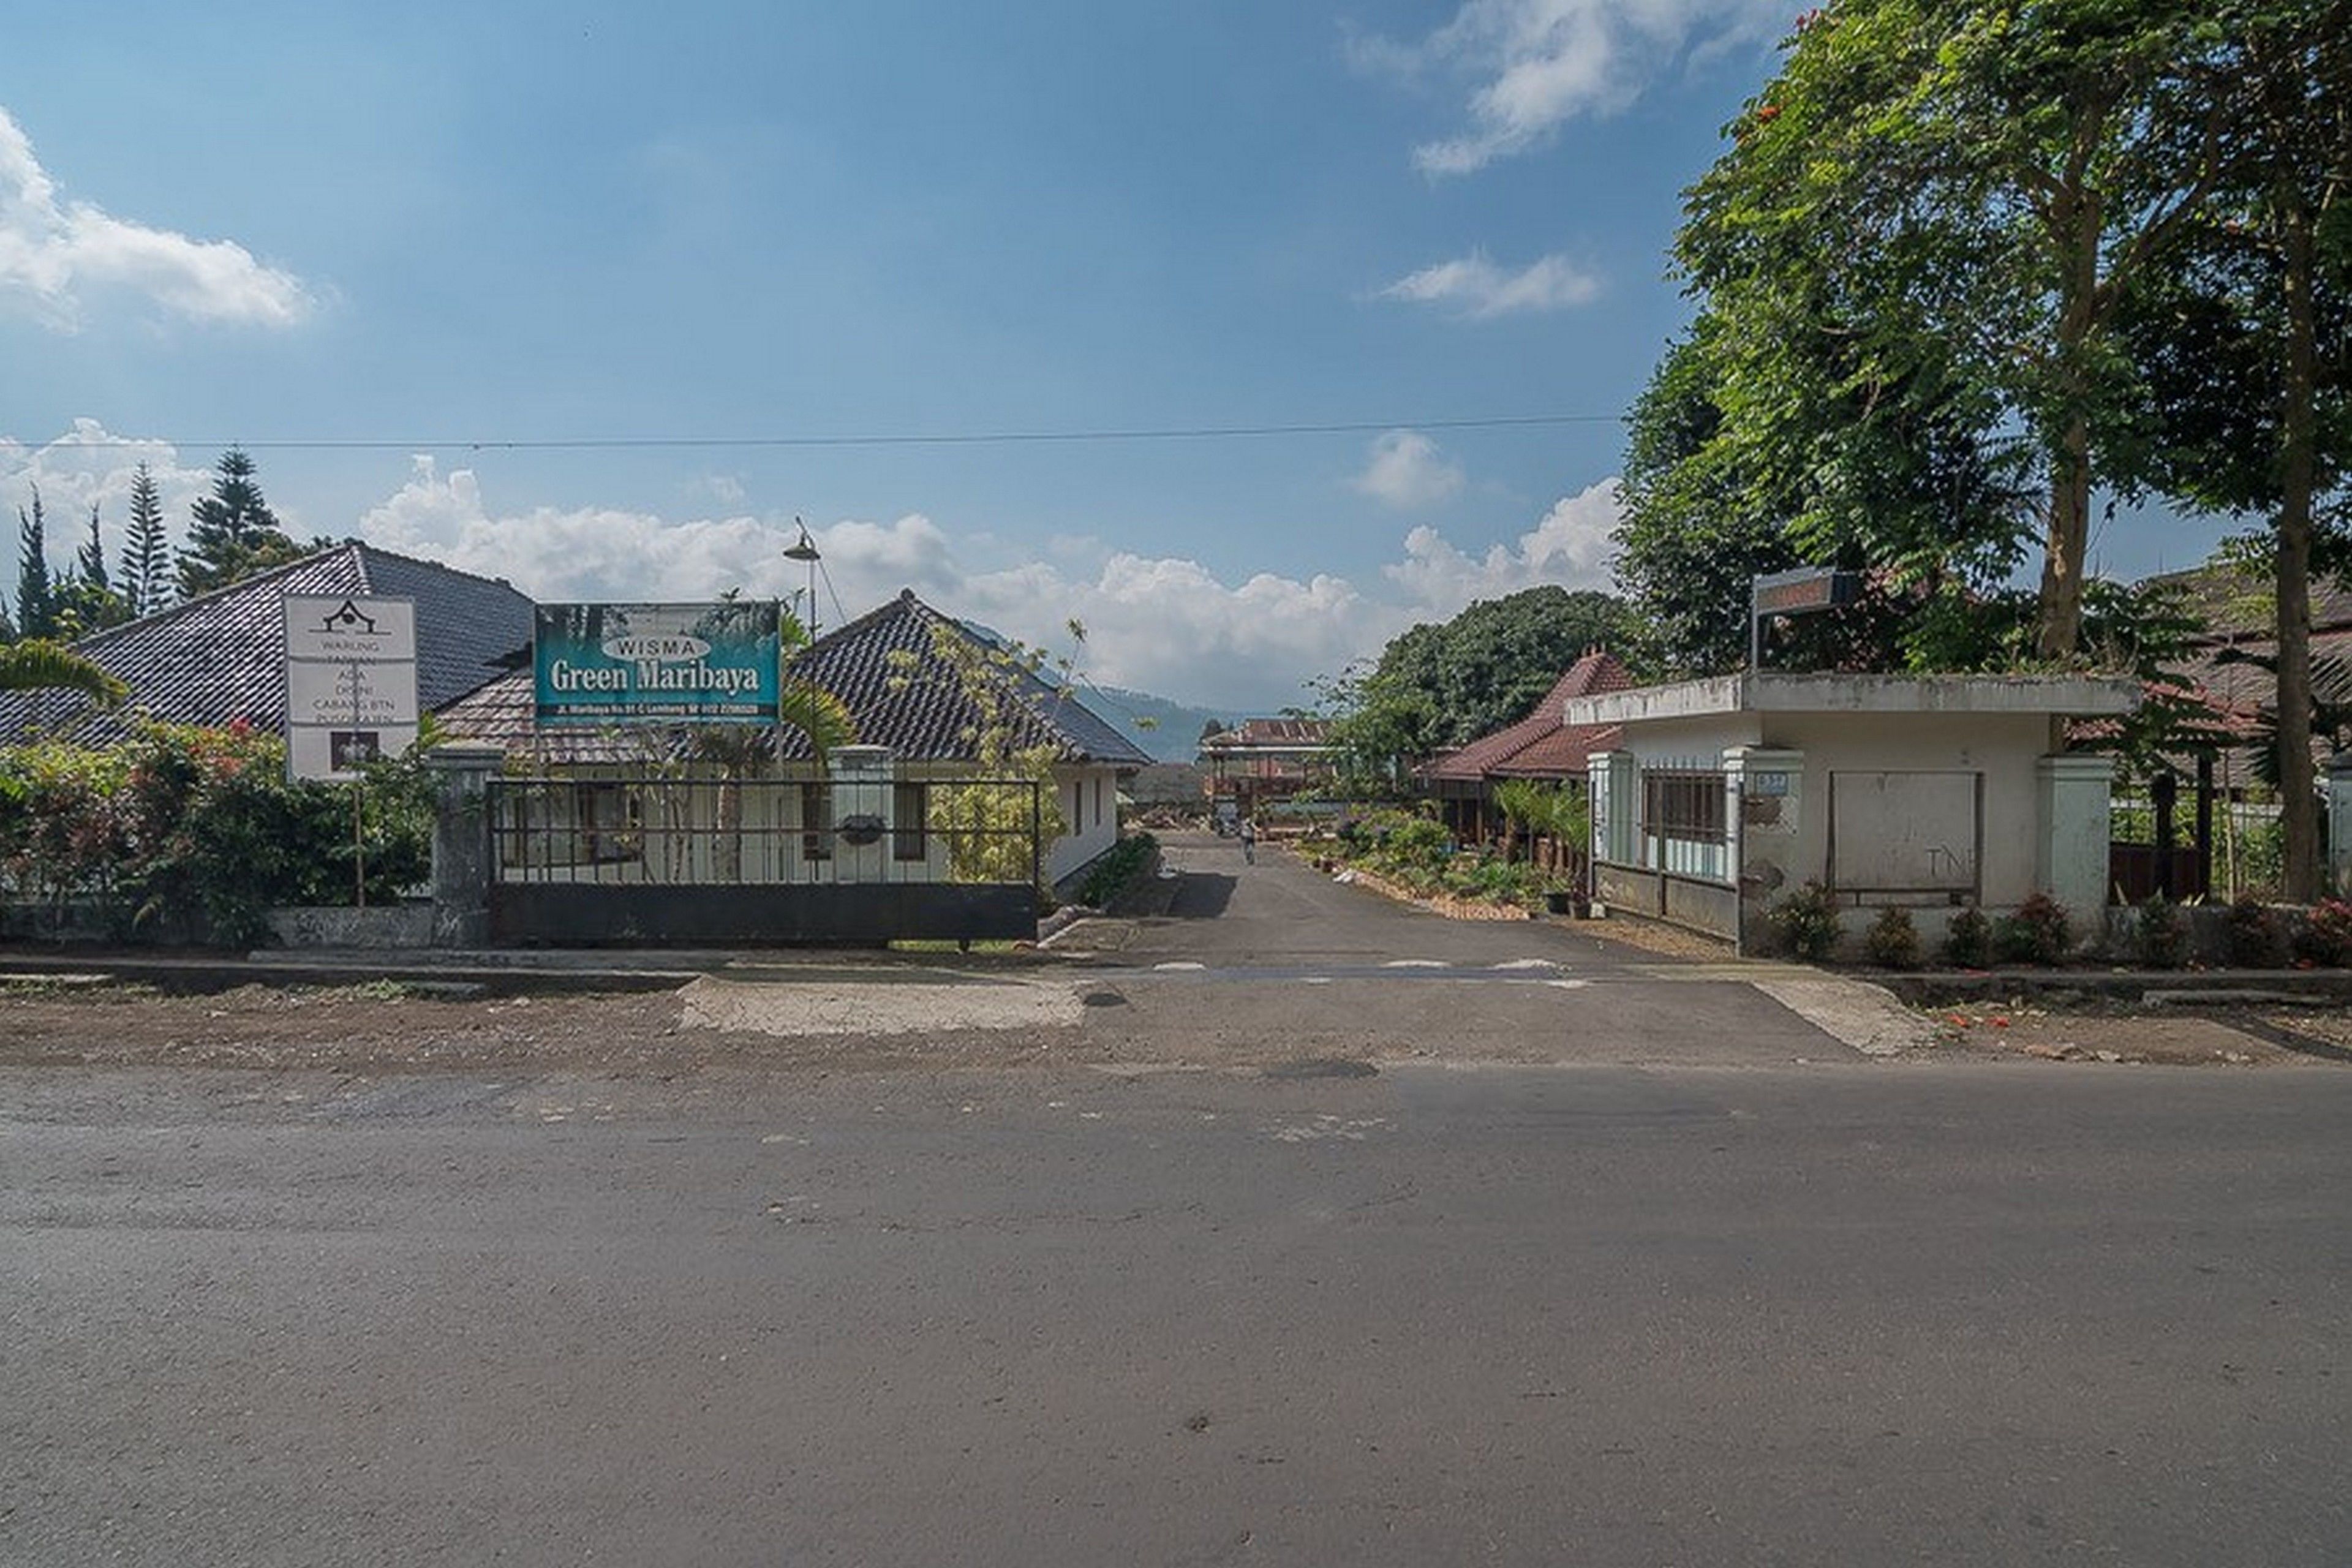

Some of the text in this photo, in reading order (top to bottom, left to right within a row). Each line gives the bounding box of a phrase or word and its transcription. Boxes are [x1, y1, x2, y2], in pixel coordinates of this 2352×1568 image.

[617, 639, 696, 655] WISMA
[551, 658, 760, 697] Green Maribaya
